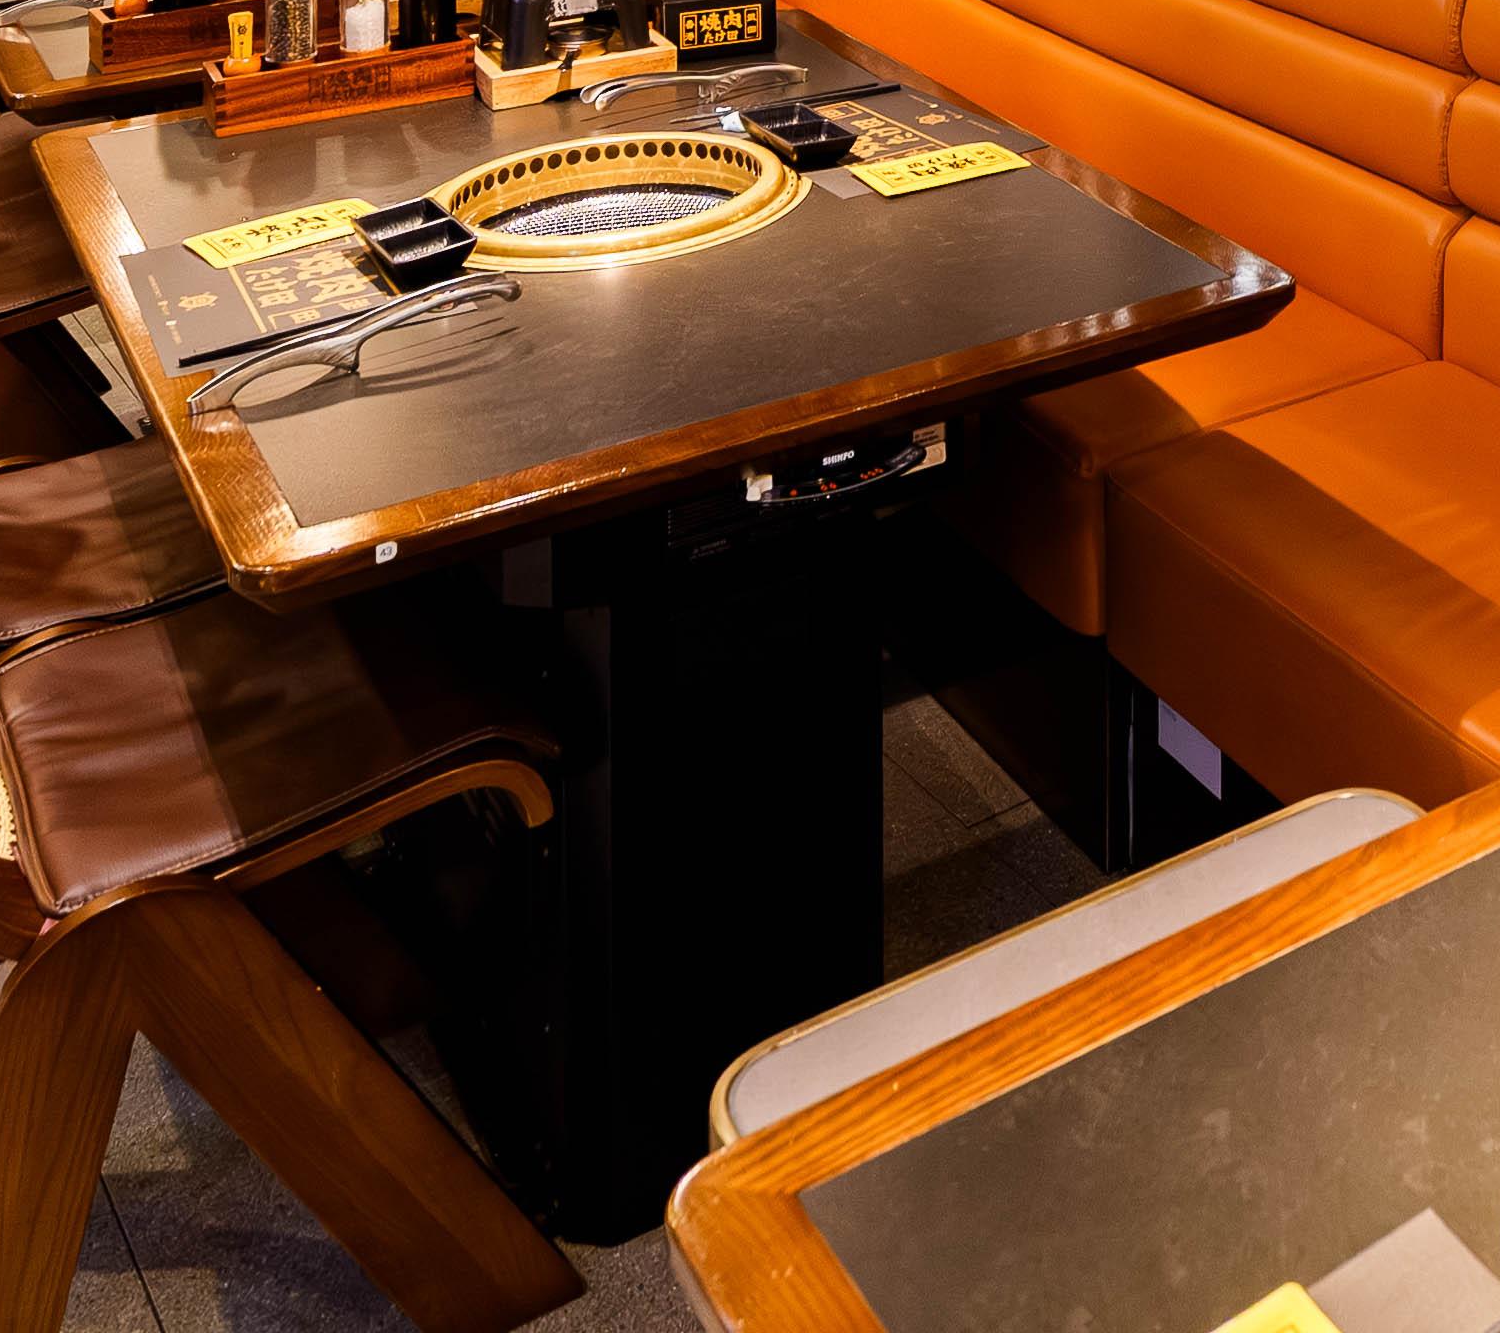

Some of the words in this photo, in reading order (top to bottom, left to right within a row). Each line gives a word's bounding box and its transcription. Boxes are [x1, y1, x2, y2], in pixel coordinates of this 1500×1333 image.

[699, 9, 743, 32] 焼肉
[704, 30, 739, 44] たけ田
